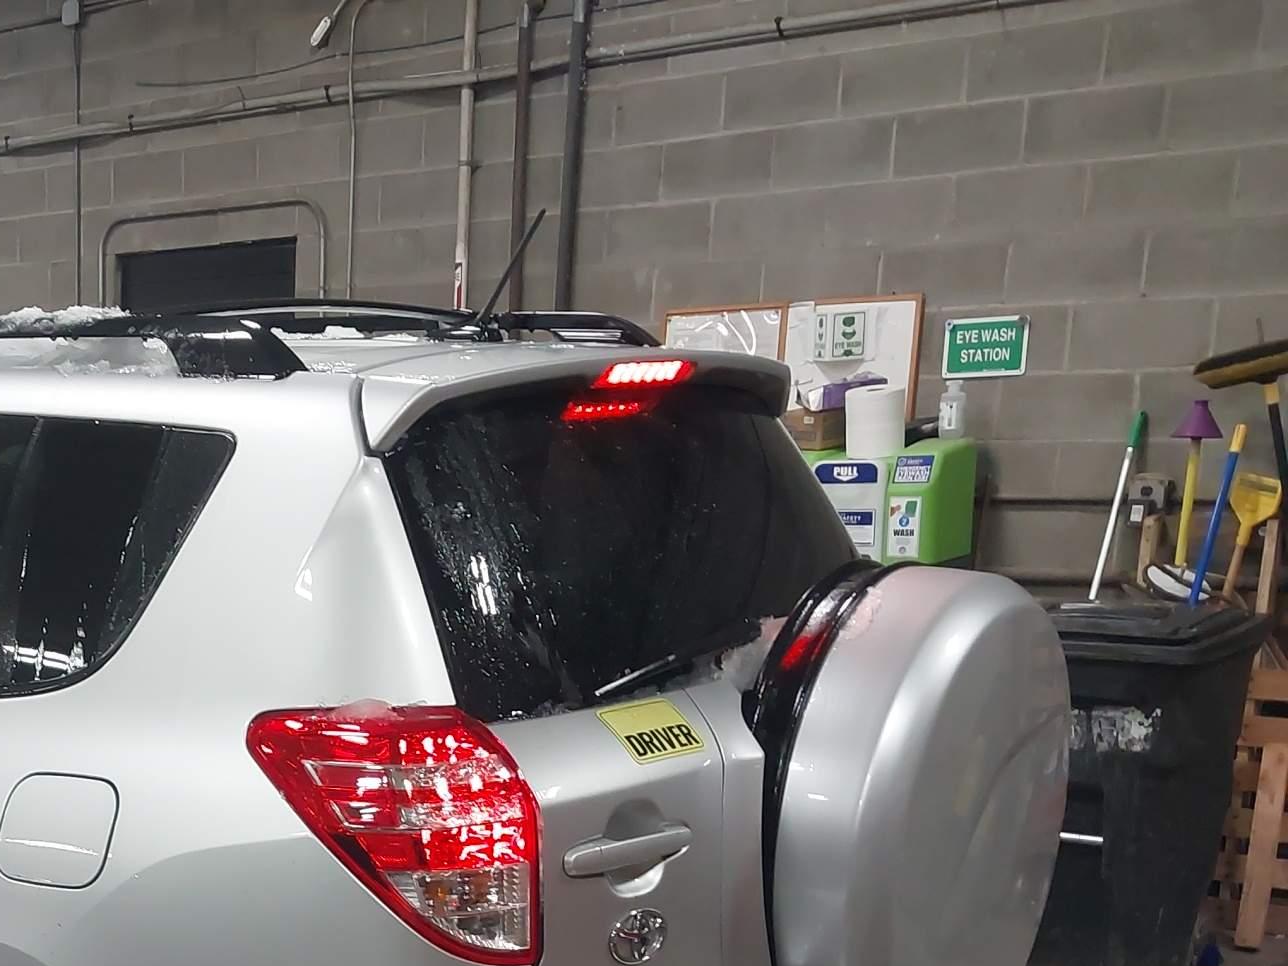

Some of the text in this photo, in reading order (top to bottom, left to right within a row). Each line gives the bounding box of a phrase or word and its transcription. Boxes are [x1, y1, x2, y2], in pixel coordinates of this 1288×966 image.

[956, 327, 1016, 344] EYE WASH
[960, 347, 1011, 364] STATION
[833, 465, 859, 477] PULL
[893, 528, 915, 537] WASH
[624, 723, 701, 759] DRIVER
